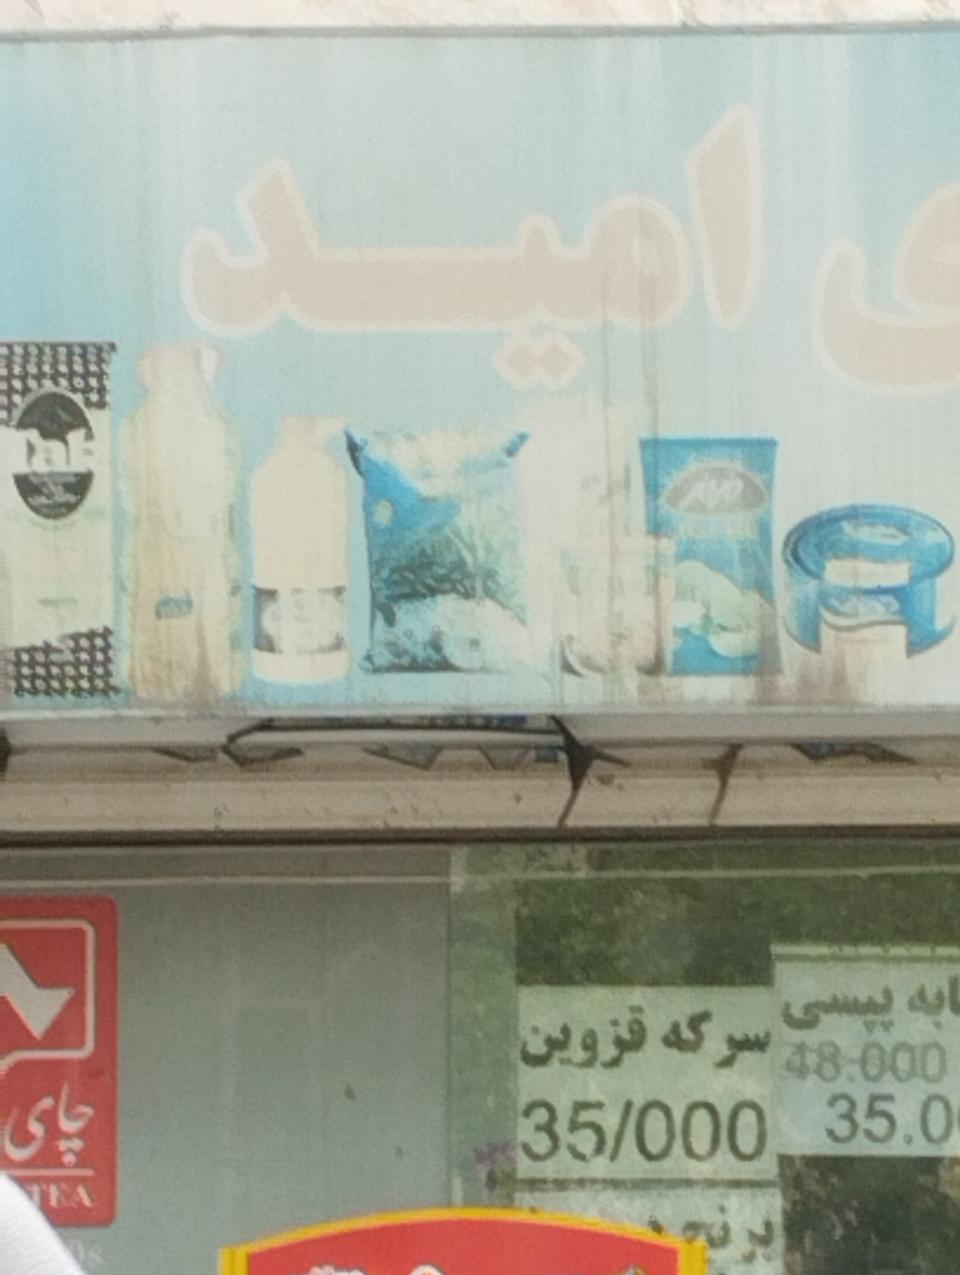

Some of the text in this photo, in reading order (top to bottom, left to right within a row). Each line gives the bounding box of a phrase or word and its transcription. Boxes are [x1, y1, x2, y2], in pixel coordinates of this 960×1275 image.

[183, 101, 765, 389] امید
[520, 1004, 771, 1069] سرکه قزوین
[782, 984, 894, 1032] پپسی
[3, 1081, 96, 1168] چای
[521, 1099, 768, 1163] 35/000
